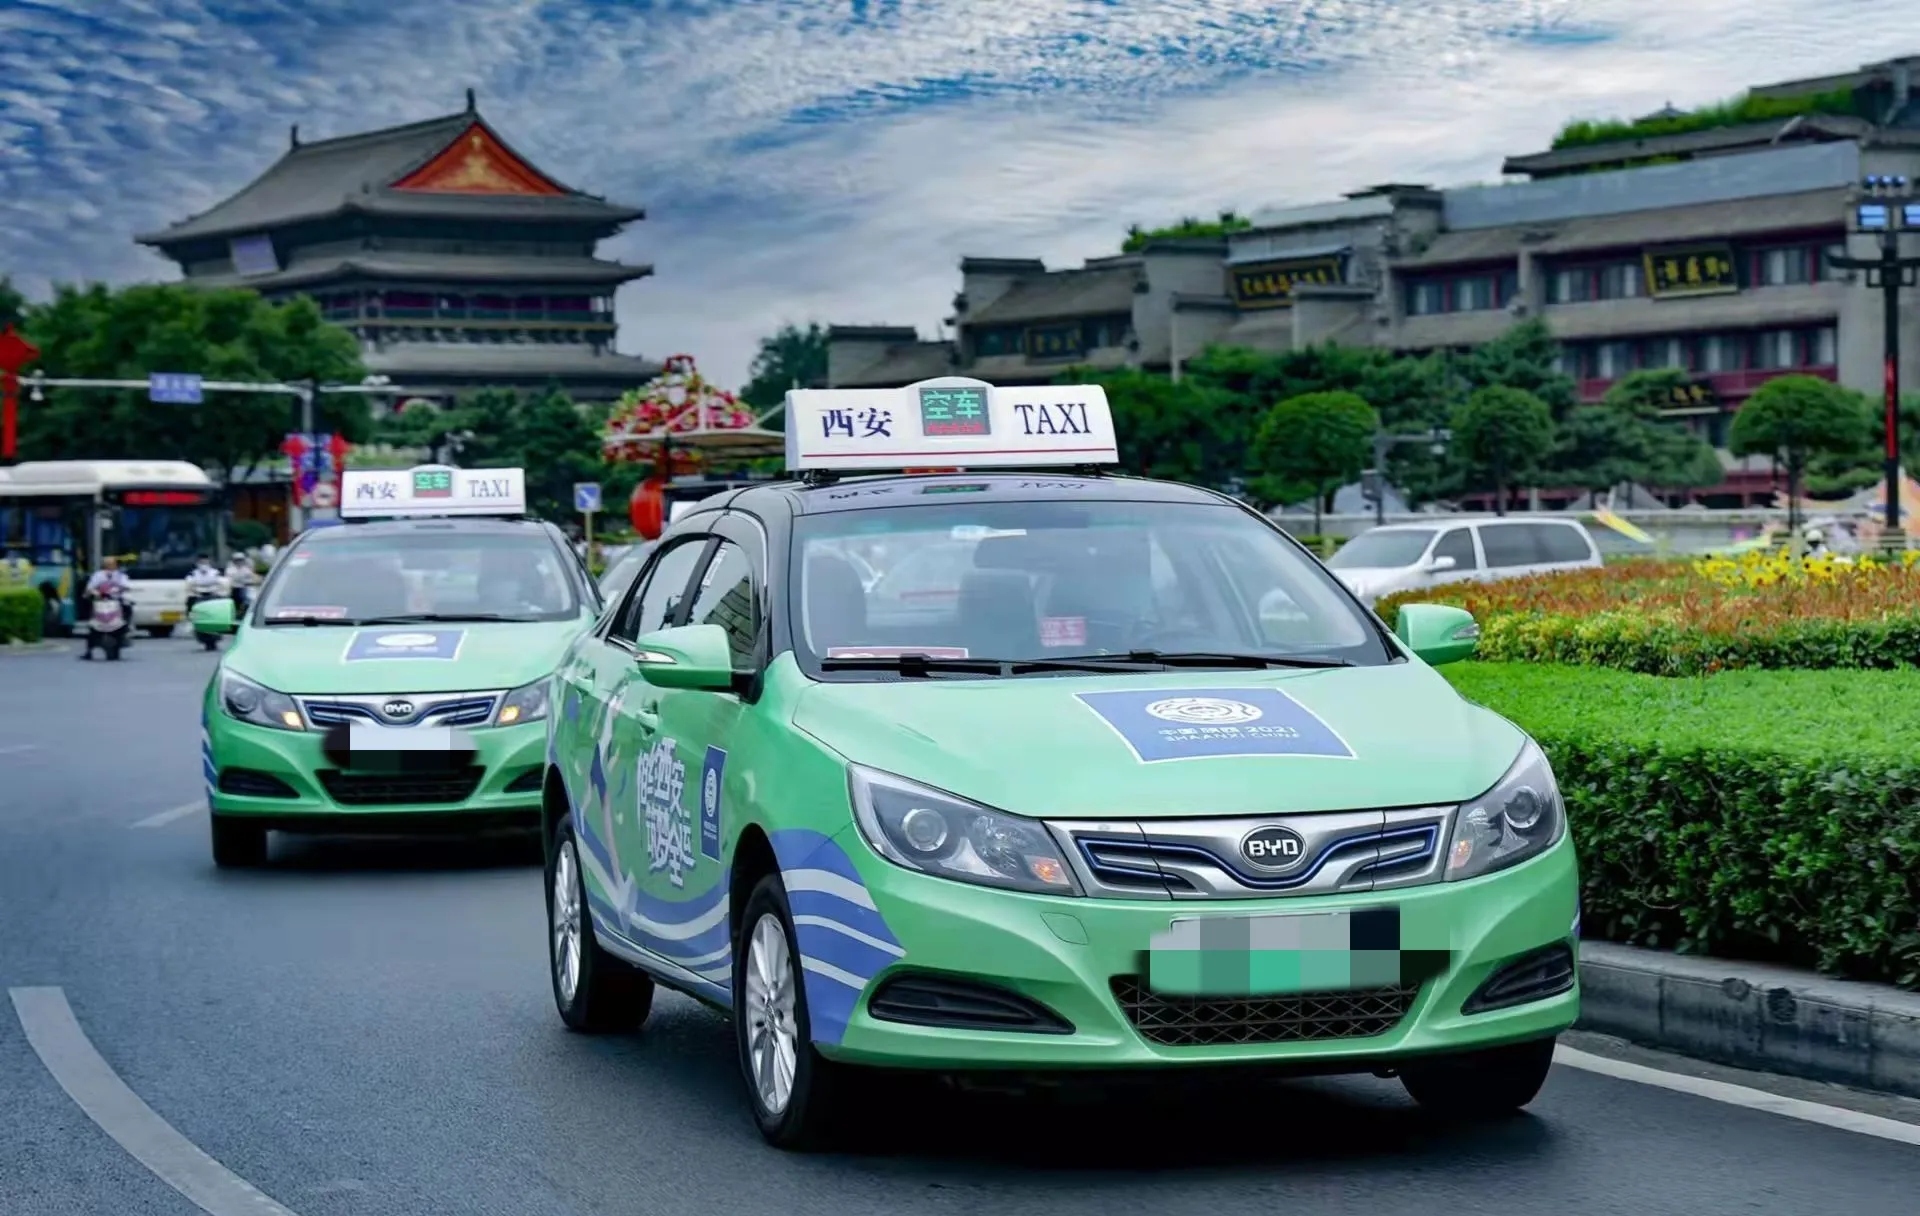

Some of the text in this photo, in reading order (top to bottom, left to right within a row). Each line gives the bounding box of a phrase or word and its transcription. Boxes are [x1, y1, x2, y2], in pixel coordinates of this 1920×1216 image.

[923, 390, 981, 419] 空车
[822, 407, 893, 439] 西安
[1014, 403, 1092, 435] TAXI
[356, 480, 398, 499] 西安
[467, 479, 510, 498] TAXI
[1248, 839, 1299, 857] BYD
